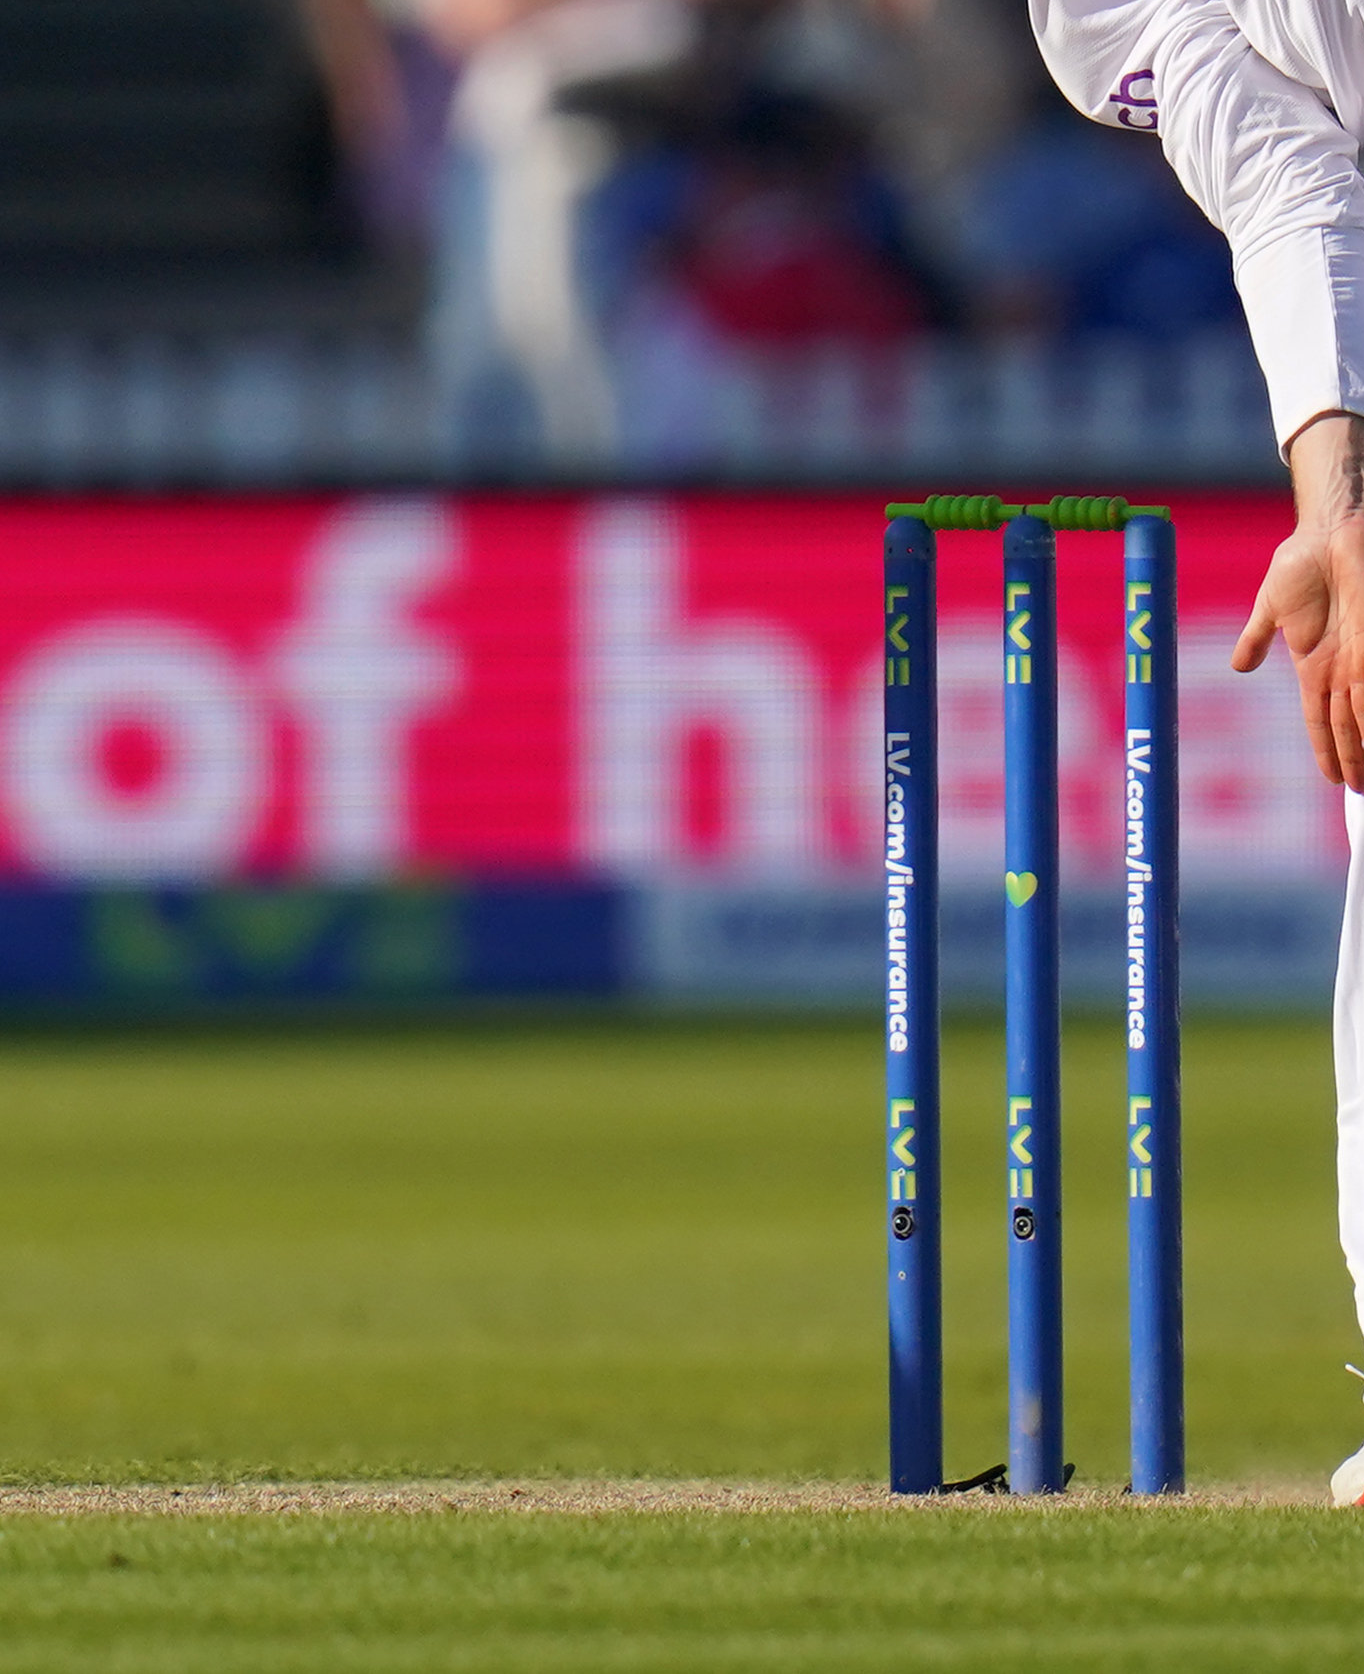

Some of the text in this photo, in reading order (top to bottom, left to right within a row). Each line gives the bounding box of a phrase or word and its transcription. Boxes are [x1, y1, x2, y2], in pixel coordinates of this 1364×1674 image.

[0, 488, 466, 882] of
[884, 731, 914, 1053] LV.com/insurance
[1125, 728, 1153, 1049] LV.com/insurance
